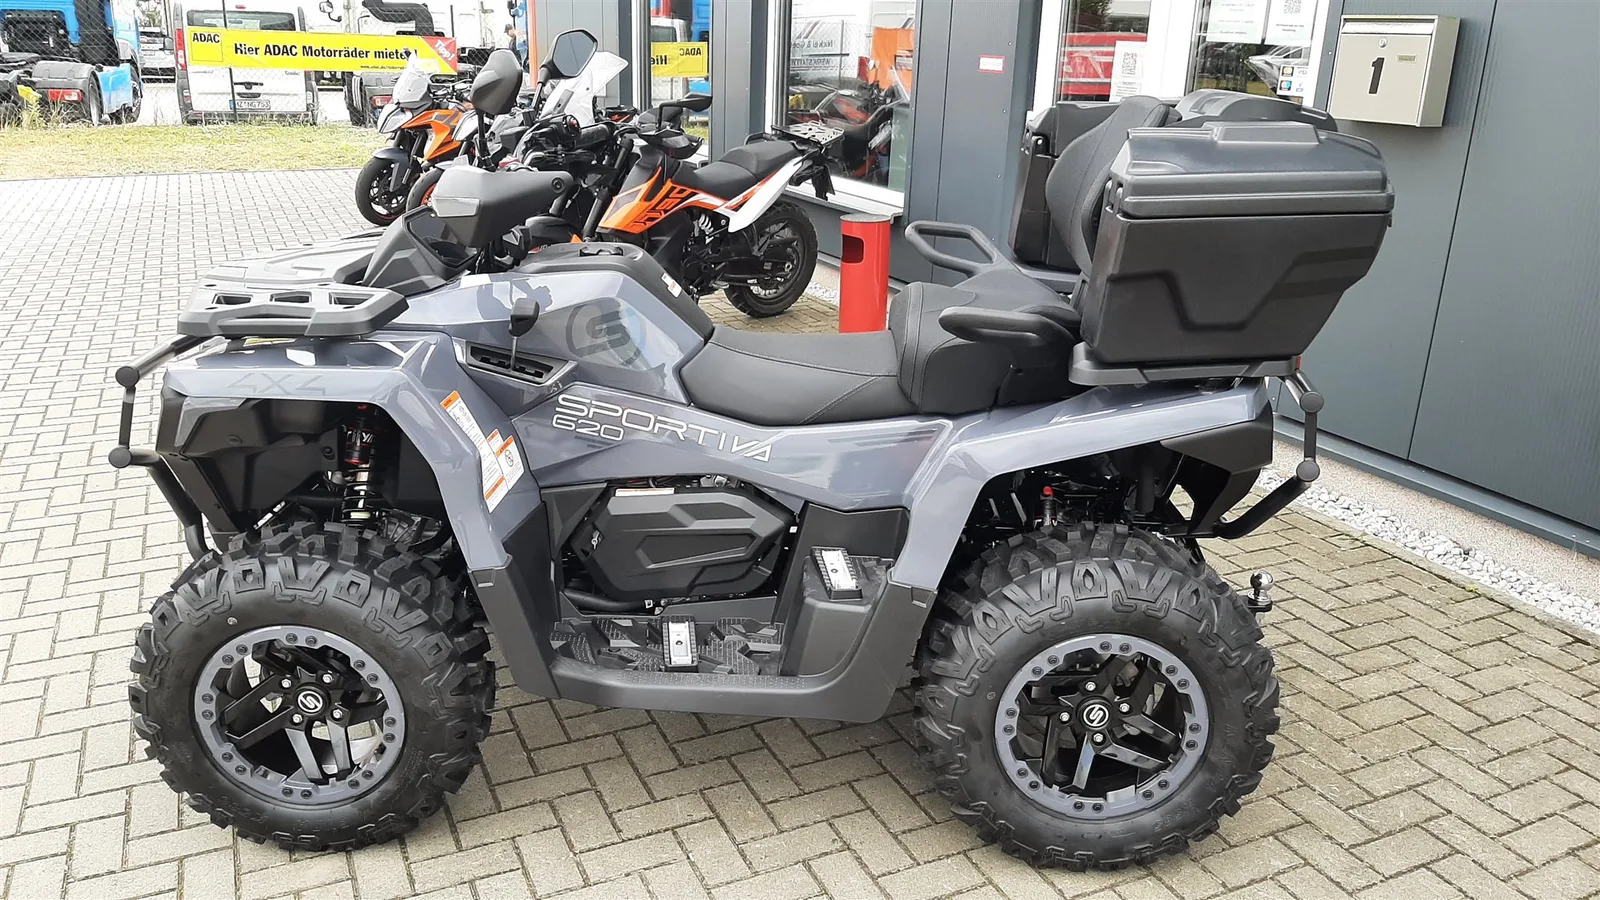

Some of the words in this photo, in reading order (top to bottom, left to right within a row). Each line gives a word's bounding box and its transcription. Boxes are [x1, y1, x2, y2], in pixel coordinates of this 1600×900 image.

[192, 32, 220, 43] ADAC
[234, 43, 260, 56] Hier
[264, 44, 298, 56] ADAC
[302, 45, 370, 58] Motorräder
[374, 48, 417, 60] miete!
[435, 39, 454, 61] Tipp!
[1368, 57, 1385, 94] 1
[552, 414, 624, 441] 620
[555, 394, 773, 462] SPORTIVA
